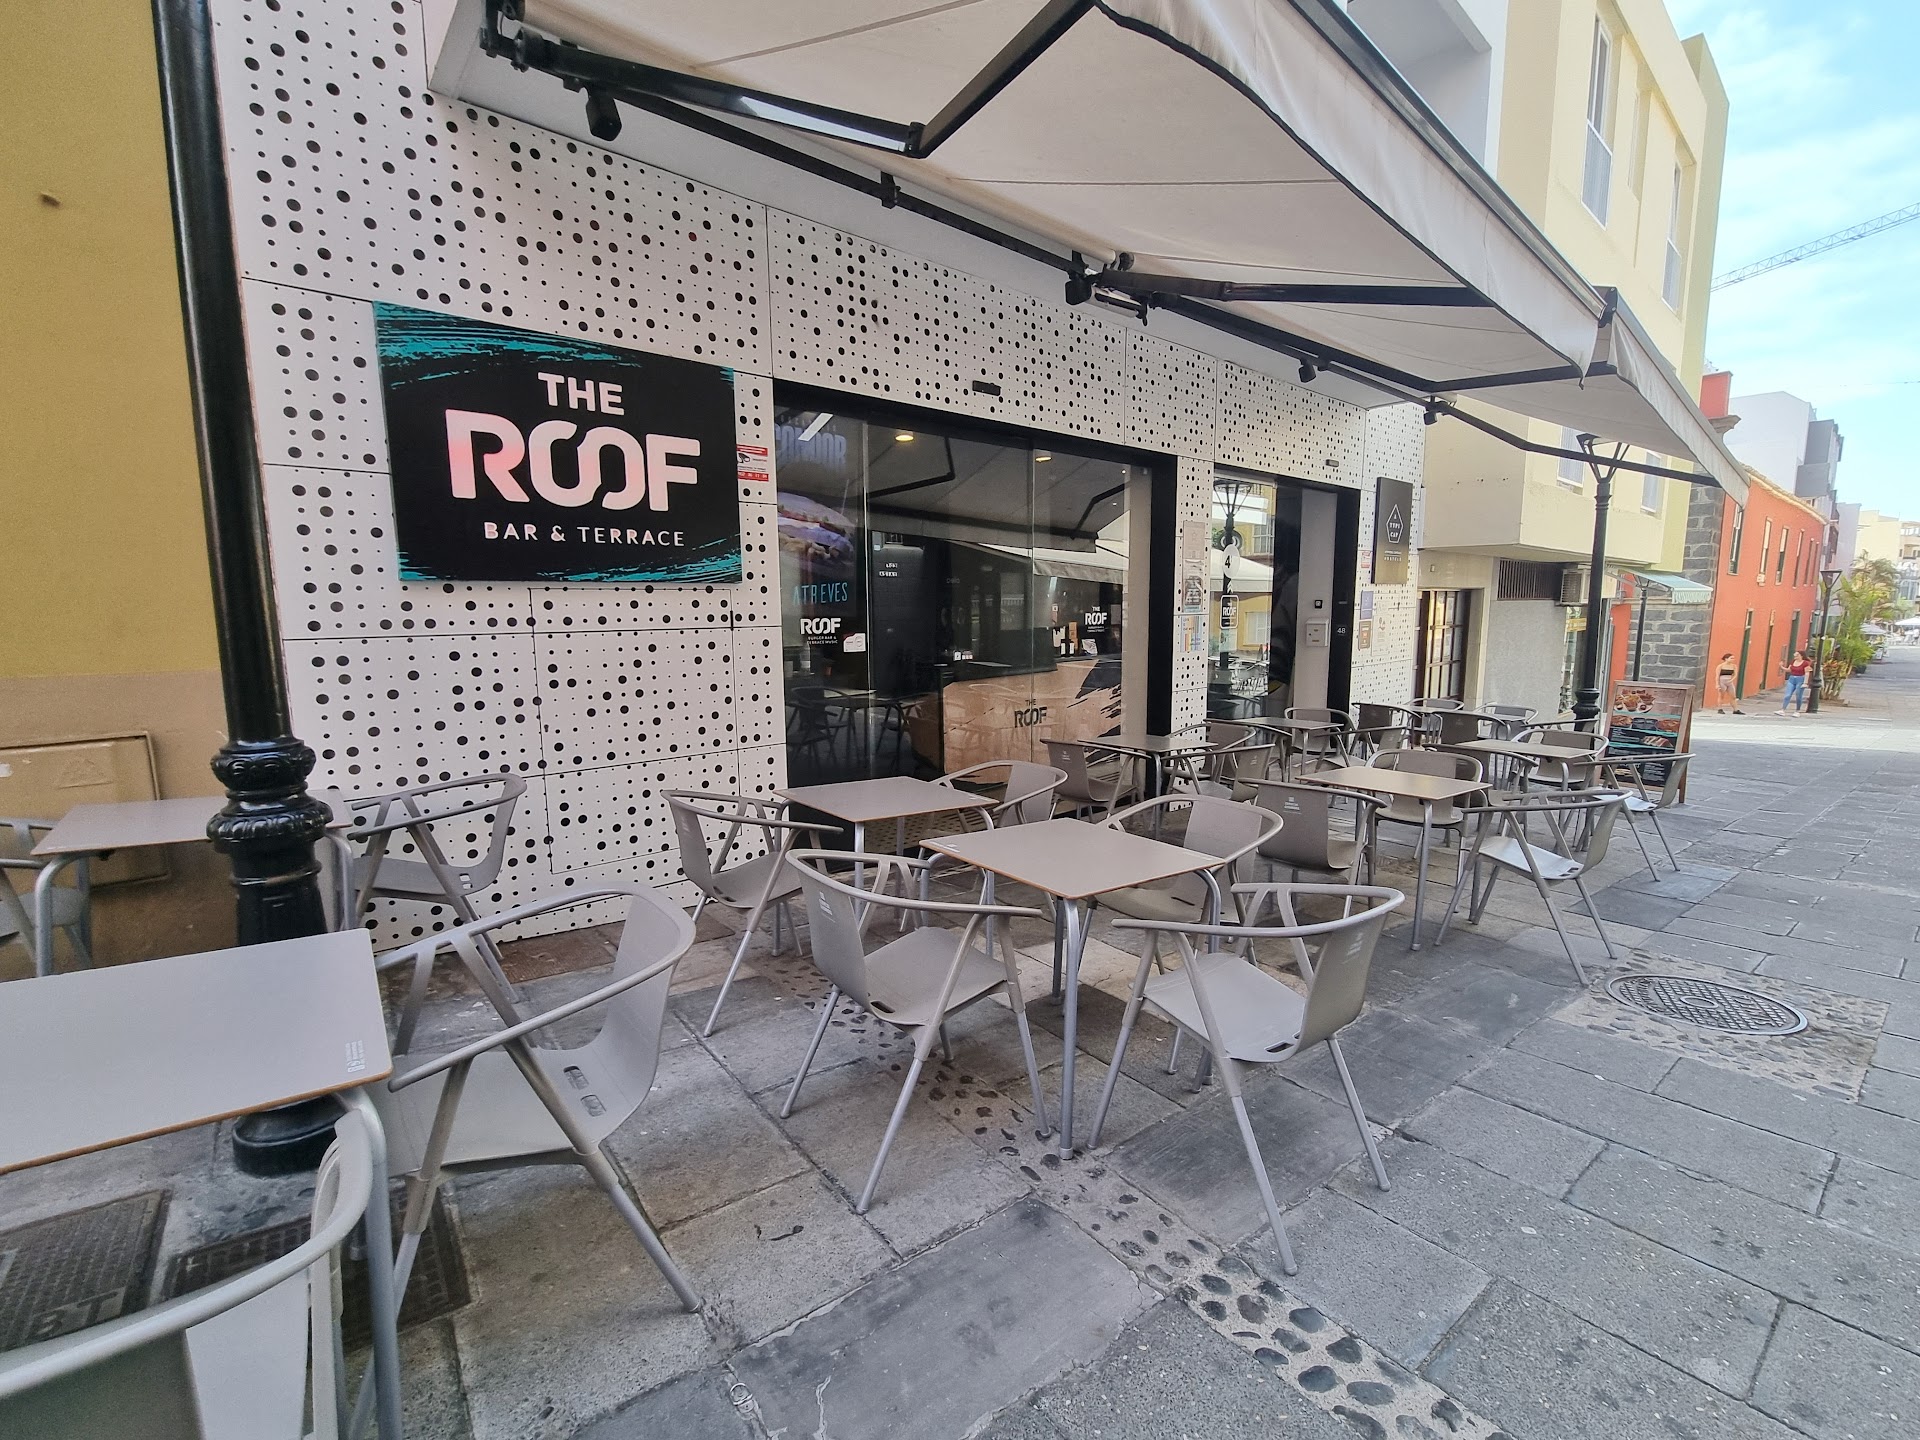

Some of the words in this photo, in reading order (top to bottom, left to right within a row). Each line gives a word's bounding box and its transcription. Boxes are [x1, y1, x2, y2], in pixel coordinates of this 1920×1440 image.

[538, 372, 625, 416] THE
[445, 408, 701, 512] ROOF
[484, 521, 539, 542] BAR
[550, 525, 566, 542] &
[576, 526, 685, 547] TERRACE
[793, 582, 849, 605] ATREVES
[1084, 612, 1108, 625] ROOF
[1222, 606, 1237, 617] ROOF
[800, 618, 842, 635] ROOF
[1014, 706, 1048, 729] ROOF
